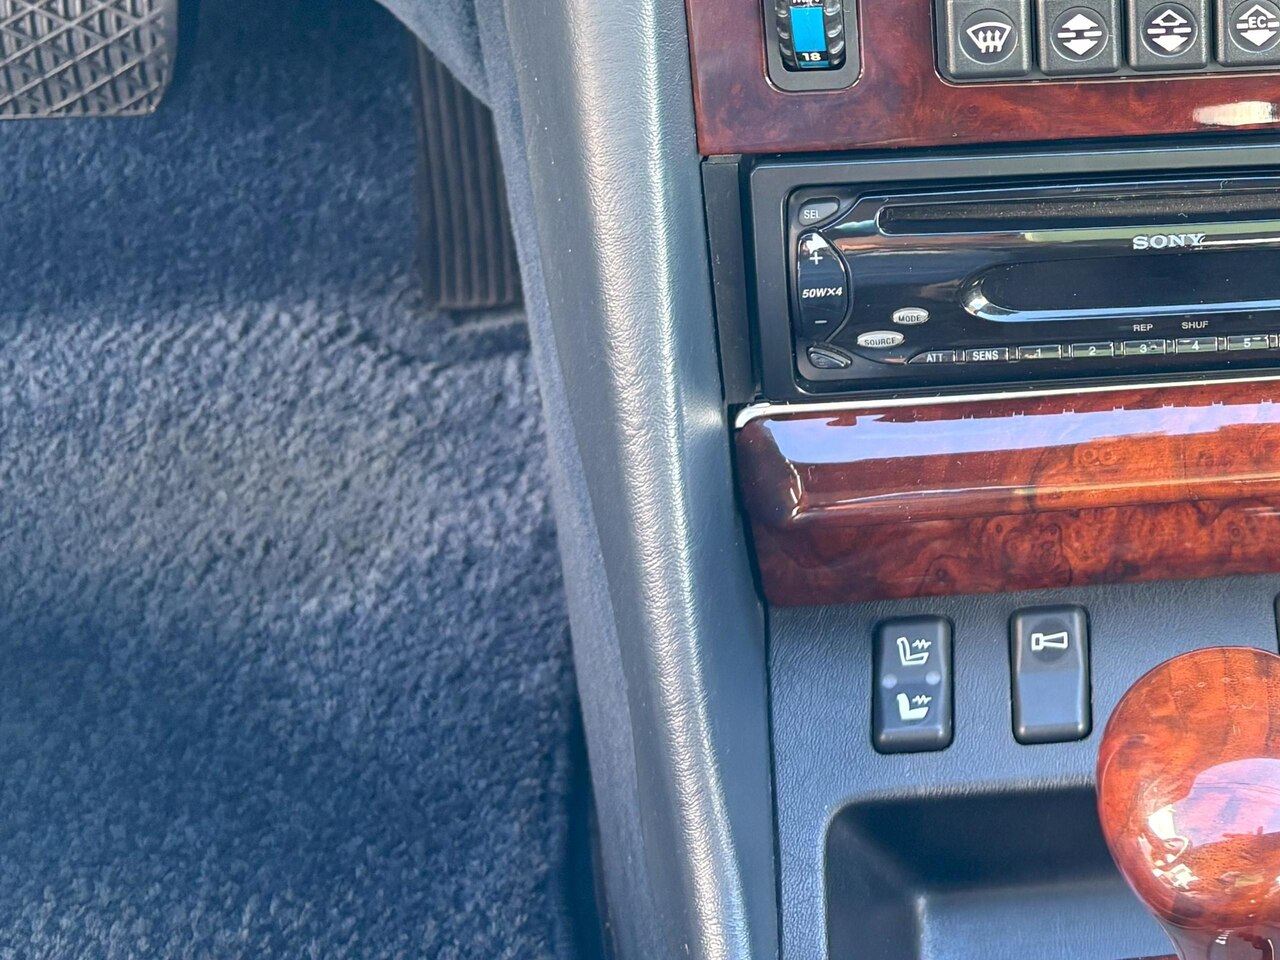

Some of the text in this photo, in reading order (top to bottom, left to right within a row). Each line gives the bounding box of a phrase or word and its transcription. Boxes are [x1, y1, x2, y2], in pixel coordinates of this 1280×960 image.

[1247, 15, 1268, 29] EC
[801, 52, 822, 62] 18
[803, 209, 821, 220] SEL
[1132, 233, 1206, 250] SONY
[898, 315, 922, 323] MODE
[1132, 320, 1209, 332] REP SHUF
[864, 336, 897, 346] SOURCE
[926, 353, 944, 363] ATT
[972, 350, 999, 361] SENS
[1088, 345, 1097, 356] 2
[1139, 343, 1148, 354] 3
[1191, 340, 1200, 351] 4
[1243, 337, 1252, 348] 5
